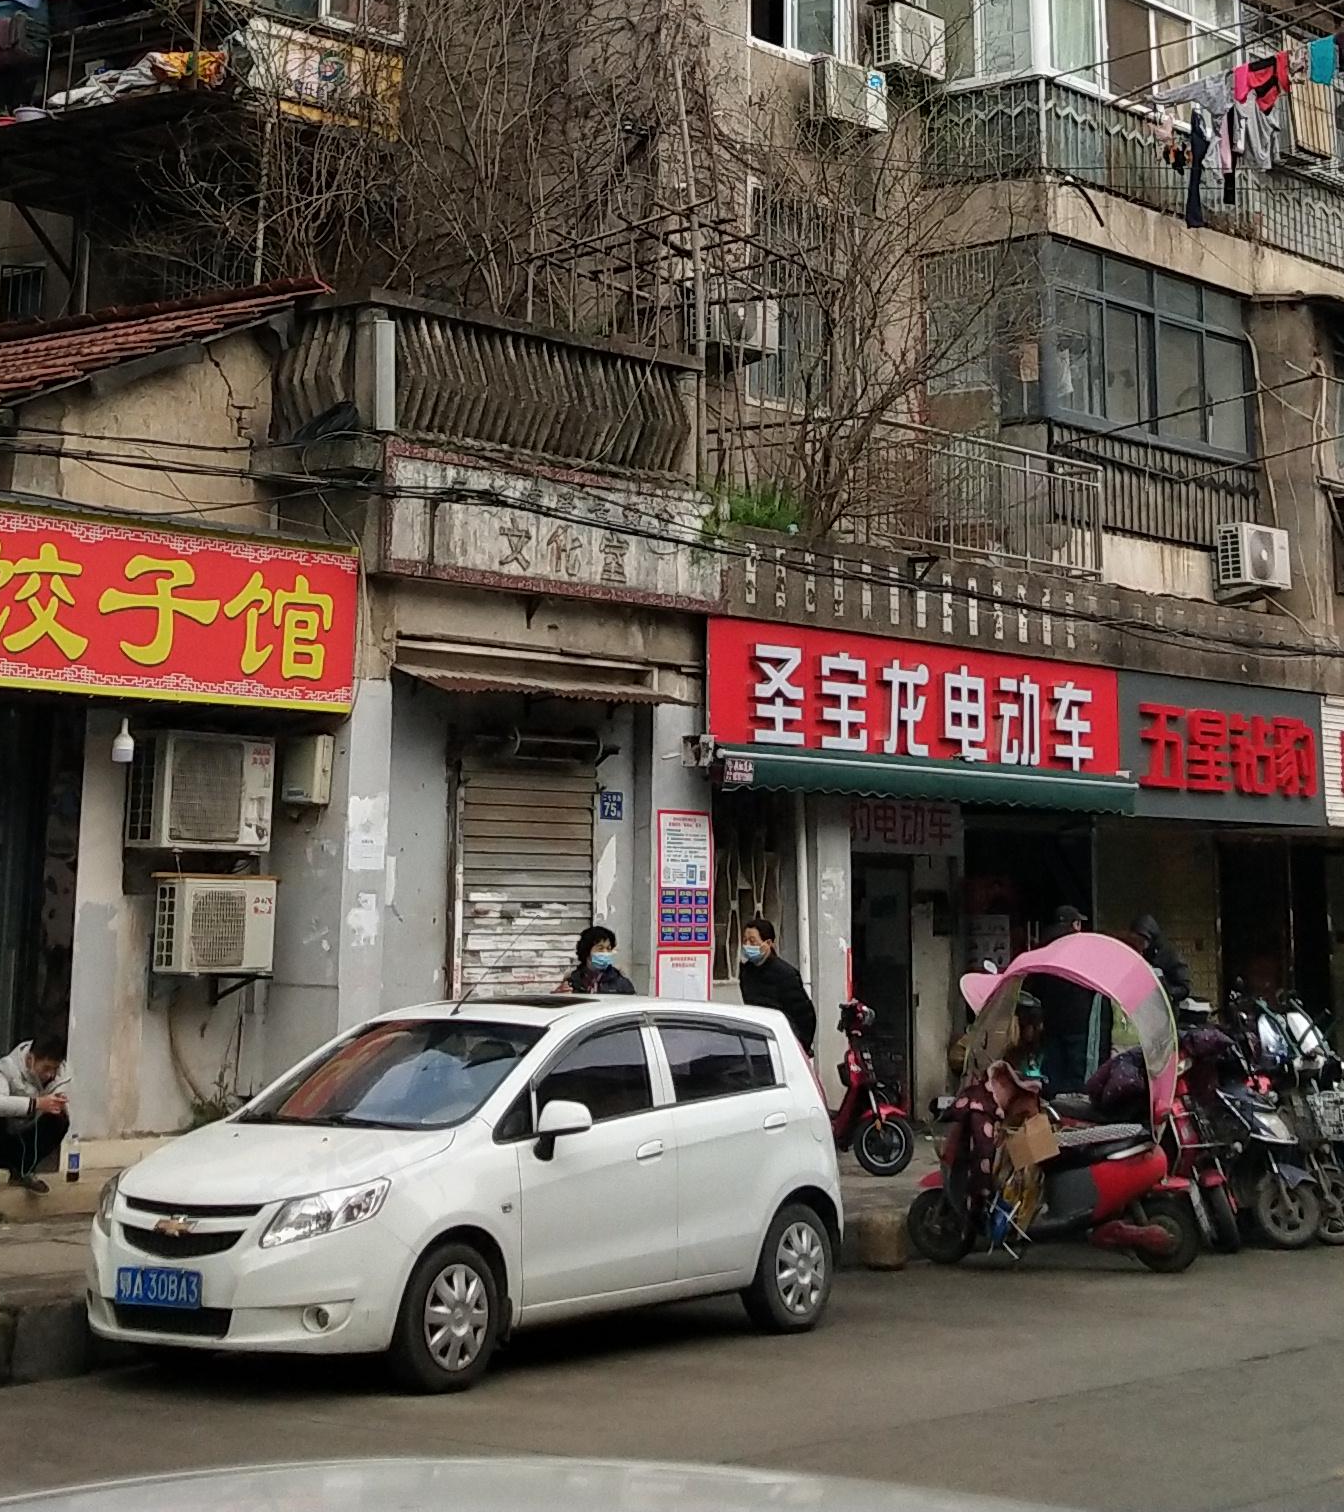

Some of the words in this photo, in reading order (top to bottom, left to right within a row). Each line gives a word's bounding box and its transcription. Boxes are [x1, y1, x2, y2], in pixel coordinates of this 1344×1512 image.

[499, 514, 630, 586] 文化室
[753, 643, 1094, 772] 圣宝龙电动车
[1139, 702, 1318, 799] 五星钻豹
